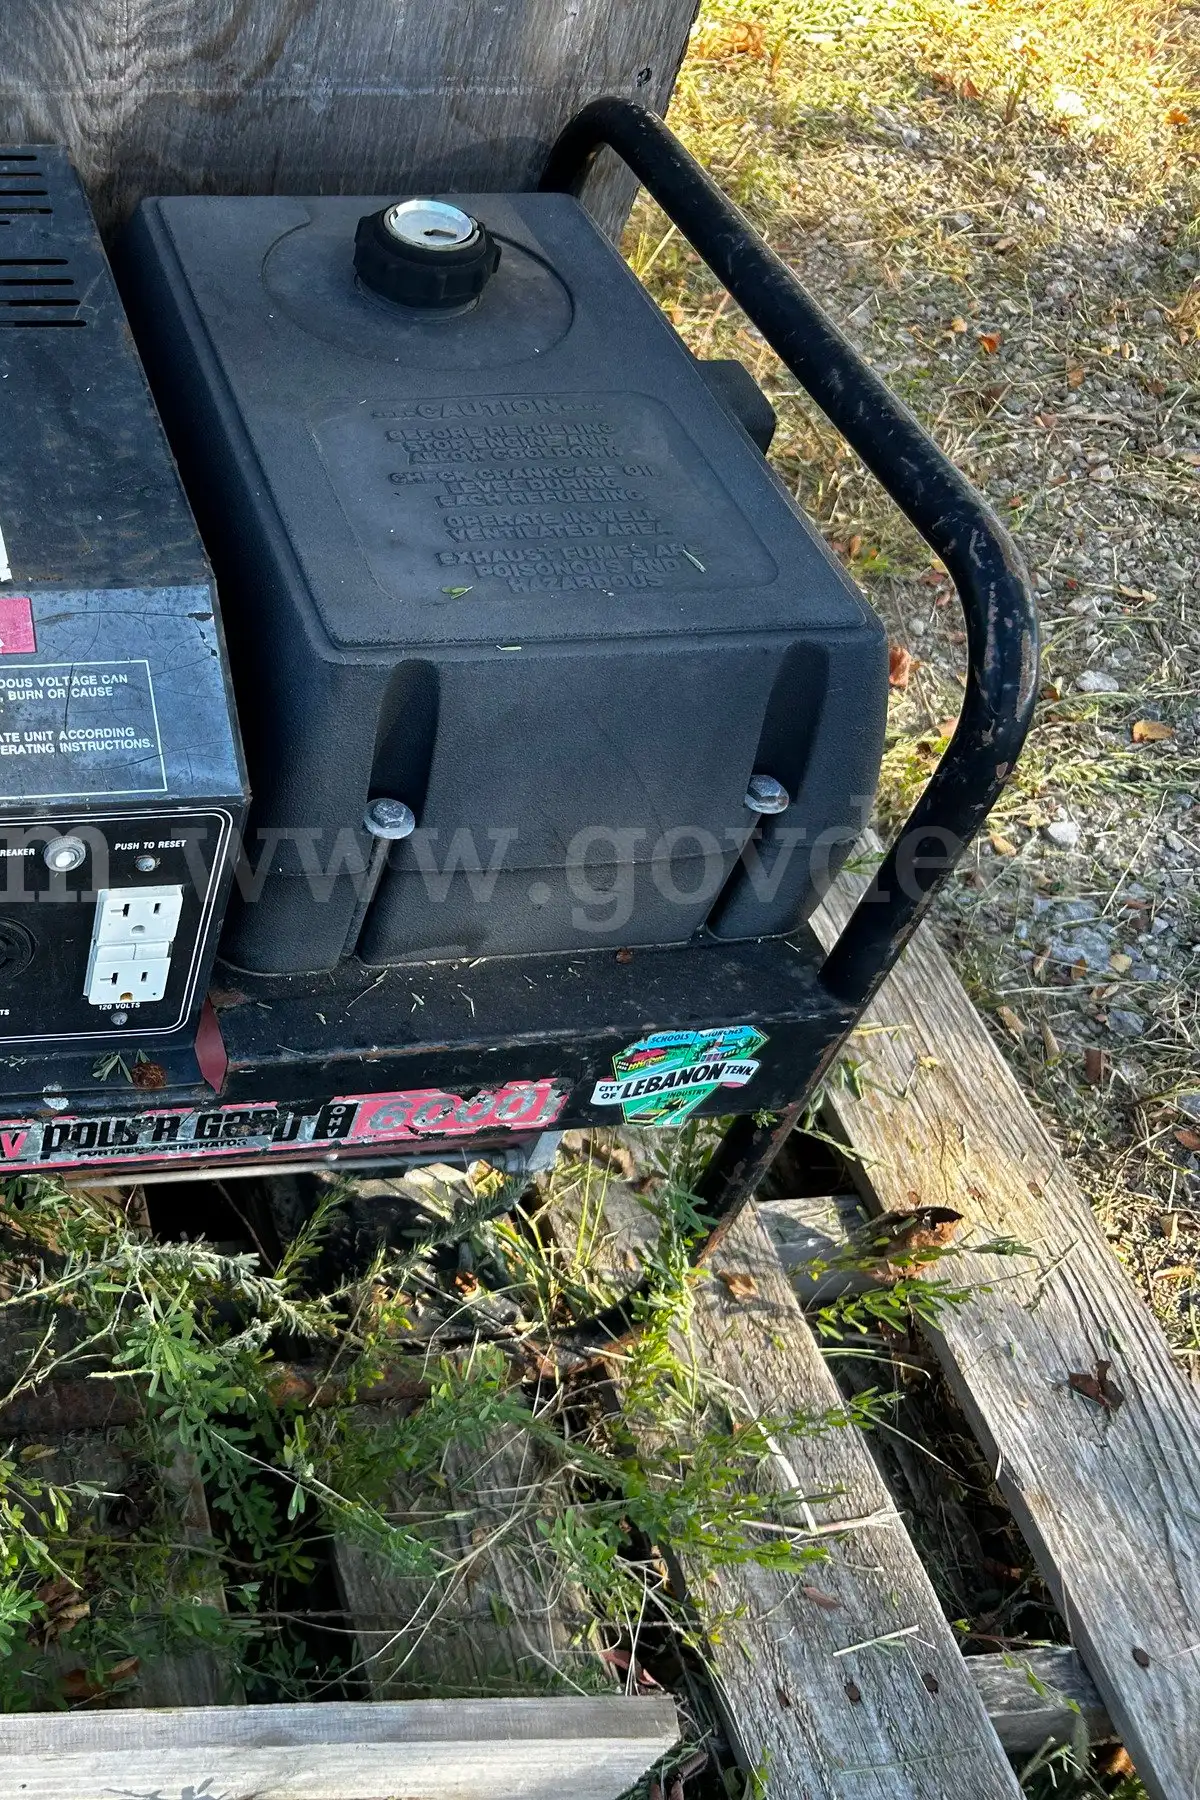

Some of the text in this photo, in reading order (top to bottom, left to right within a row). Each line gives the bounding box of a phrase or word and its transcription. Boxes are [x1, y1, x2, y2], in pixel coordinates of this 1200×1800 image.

[416, 400, 557, 419] CAUTION
[484, 424, 617, 438] REFUELING
[403, 434, 612, 451] STOP ENGINE AND
[475, 466, 620, 481] CRANKCASE
[444, 478, 621, 494] LEVEL DURING
[506, 488, 644, 505] REFUELING
[444, 512, 559, 528] OPERATE
[593, 509, 660, 522] WELL
[445, 524, 599, 542] VENTILATED
[436, 545, 648, 566] EXHAUST FUMES
[474, 558, 681, 580] POISONOUS AND
[506, 575, 664, 594] HAZARDOUS
[37, 675, 97, 687] VOLTAGE
[102, 674, 128, 685] CAN
[8, 689, 43, 700] BURN
[48, 688, 66, 699] OR
[71, 687, 113, 698] CAUSE
[25, 731, 54, 742] UNIT
[59, 727, 134, 741] ACCORDING
[60, 739, 154, 753] INSTRUCTIONS.
[115, 839, 187, 850] PUSH TO RESET
[651, 1033, 690, 1043] SCHOOLS
[599, 1084, 623, 1092] CITY
[620, 1062, 728, 1099] LEBANON
[601, 1092, 617, 1100] OF
[667, 1087, 707, 1099] INDUSTRY
[370, 1089, 538, 1131] 6000
[326, 1105, 347, 1138] OHV
